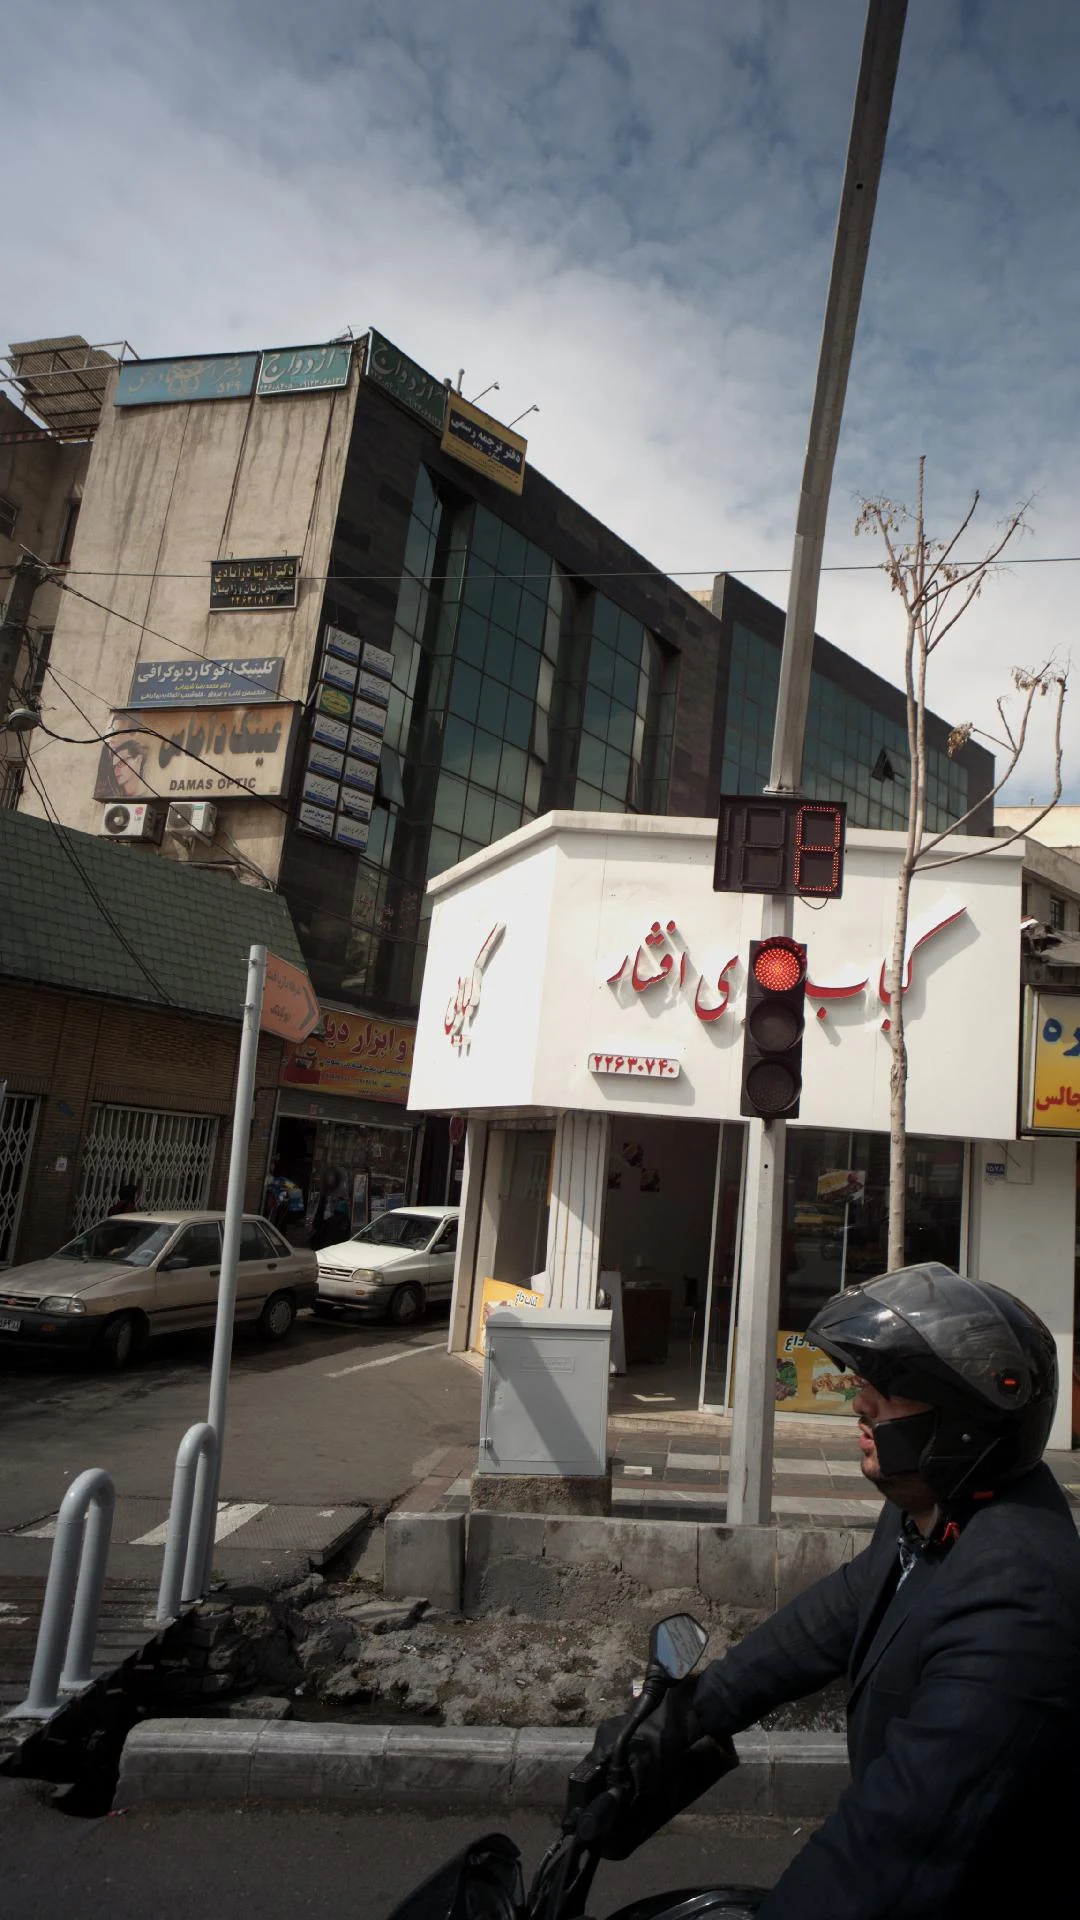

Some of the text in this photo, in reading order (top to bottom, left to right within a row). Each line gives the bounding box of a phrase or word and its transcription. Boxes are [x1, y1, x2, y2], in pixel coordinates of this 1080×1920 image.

[261, 348, 336, 384] ازدواج
[451, 419, 477, 438] رسمی
[478, 431, 504, 453] ترجمه
[503, 448, 521, 463] دفتر
[275, 563, 294, 580] دکتر
[212, 584, 238, 596] زایمان
[244, 583, 261, 594] زنان
[262, 581, 294, 594] متخصص
[234, 660, 277, 678] کلینیک
[169, 777, 257, 791] DAMAS OPTIC
[606, 920, 687, 992] افشار
[351, 1023, 395, 1057] ابزار
[593, 1055, 675, 1076] ۲۲۶۳۰۷۴۰
[1036, 1086, 1080, 1113] جالس
